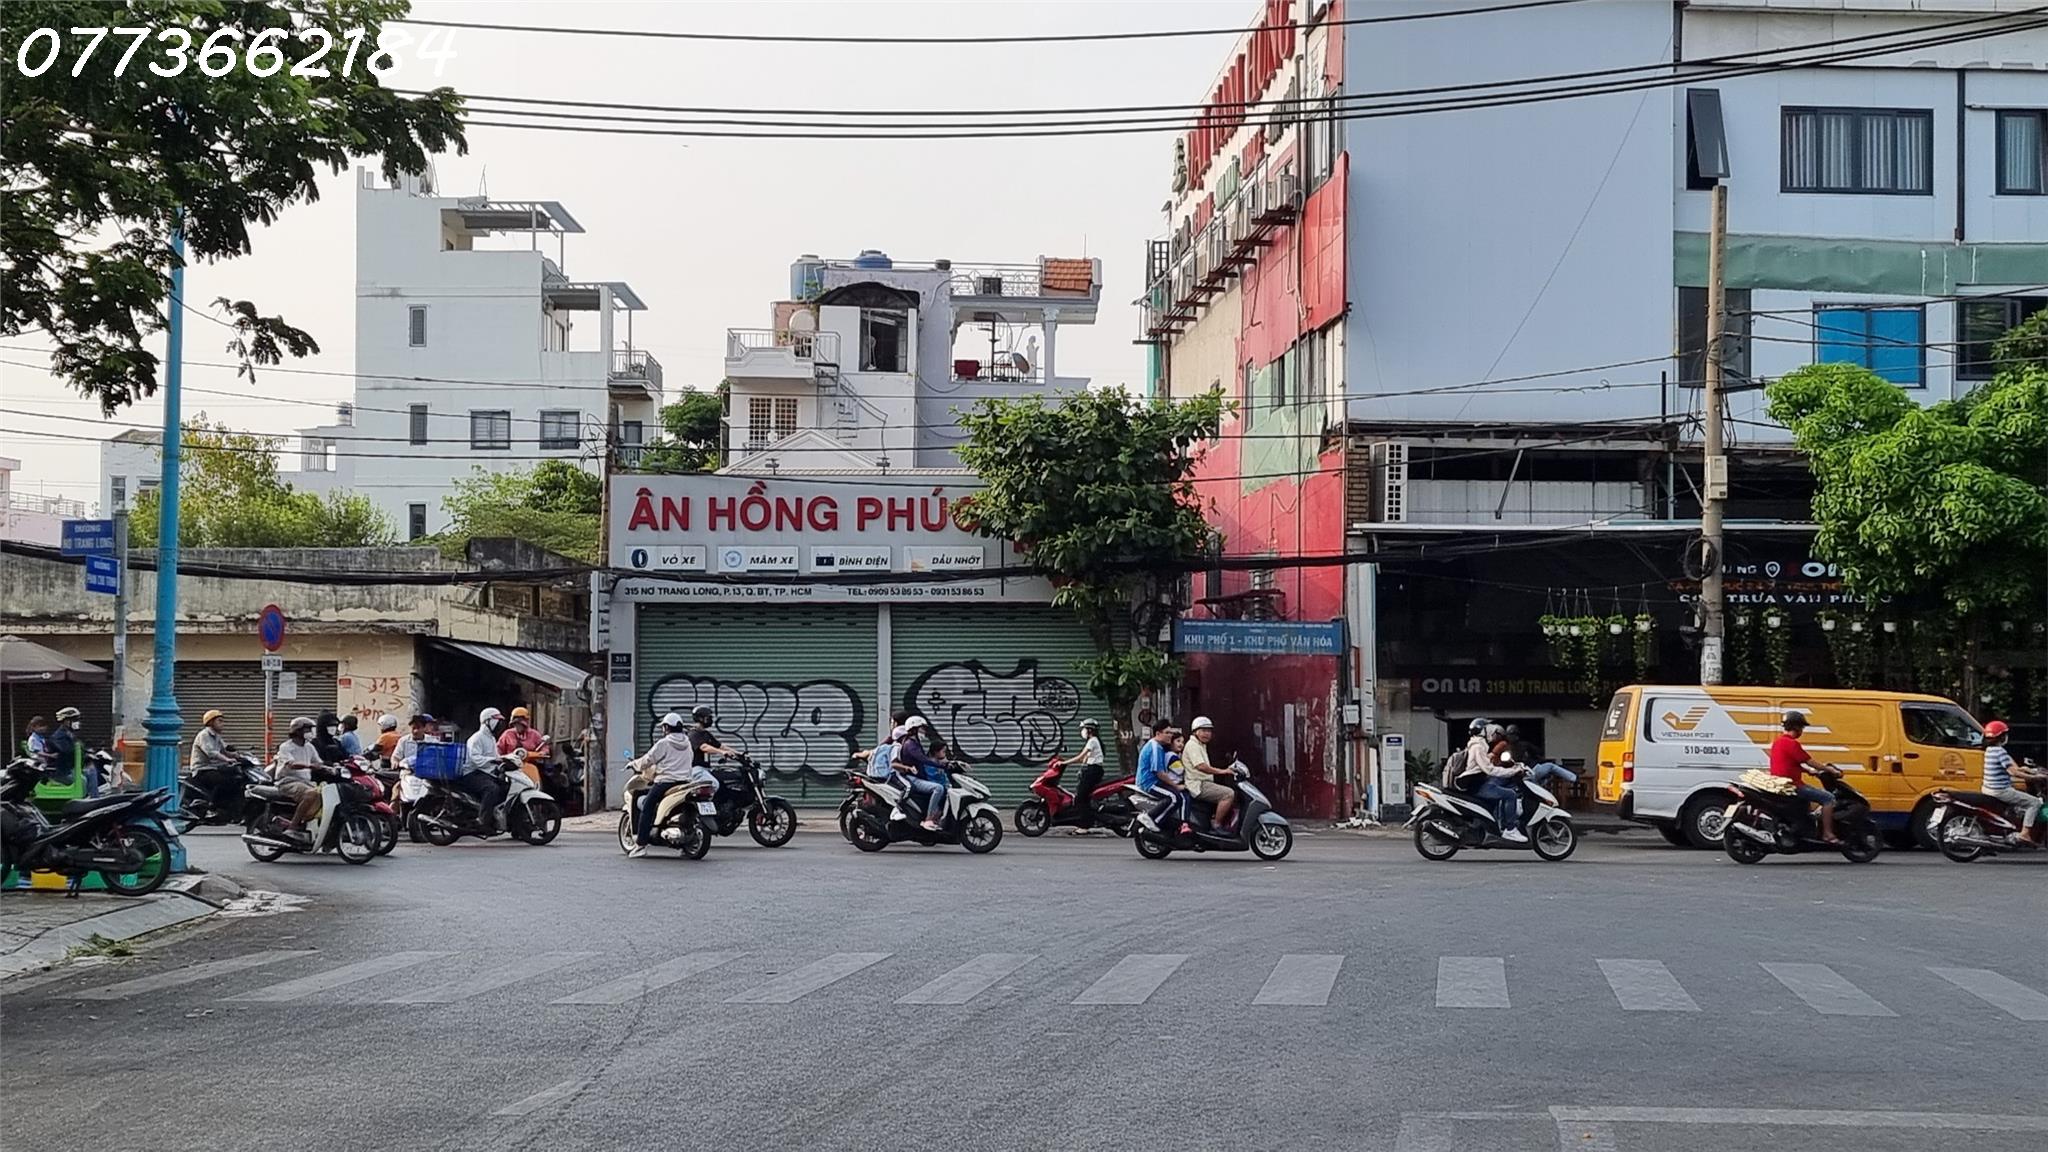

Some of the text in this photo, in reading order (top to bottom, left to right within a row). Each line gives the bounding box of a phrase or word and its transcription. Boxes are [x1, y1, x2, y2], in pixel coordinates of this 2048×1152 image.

[628, 487, 690, 531] ÂN
[708, 481, 838, 531] HỒNG
[681, 556, 696, 565] XE
[750, 554, 794, 565] MÂM XE
[625, 587, 639, 596] 315
[658, 587, 690, 596] TRANG
[791, 587, 812, 597] HCM
[1184, 634, 1204, 645] KHU
[1207, 631, 1228, 645] PHỐ
[1229, 636, 1236, 645] 1
[1244, 635, 1264, 646] KHU
[1267, 633, 1288, 646] PHỐ
[1313, 635, 1333, 648] HÓA
[1486, 679, 1505, 693] 319
[1528, 679, 1564, 693] TRANG
